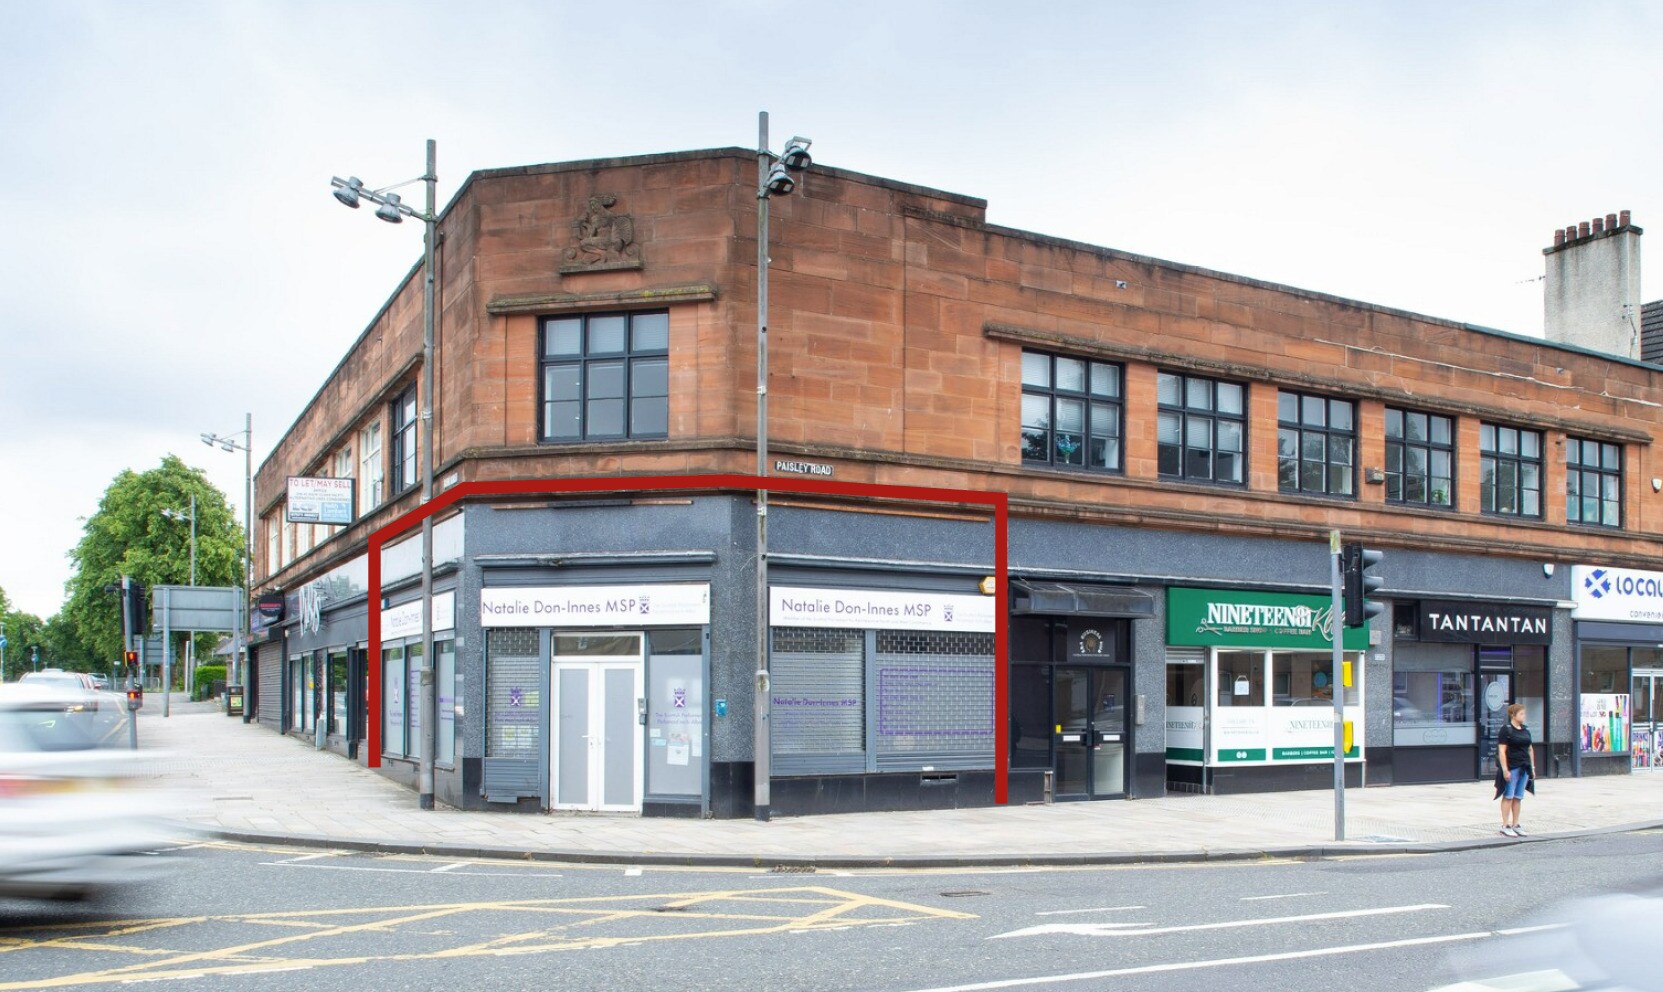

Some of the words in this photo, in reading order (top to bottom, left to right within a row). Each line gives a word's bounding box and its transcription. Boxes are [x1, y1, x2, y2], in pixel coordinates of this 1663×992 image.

[776, 461, 808, 473] PAISLEY
[810, 463, 832, 475] ROAD
[289, 479, 299, 487] TO
[301, 480, 332, 488] LET/MAY
[334, 481, 351, 489] SELL
[482, 600, 529, 614] Natalie
[534, 599, 601, 614] Don-Innes
[605, 599, 636, 613] MSP
[782, 599, 830, 613] Natalie
[835, 600, 900, 616] Don-Innes
[903, 604, 931, 617] MSP
[1429, 613, 1547, 634] TANTANTAN
